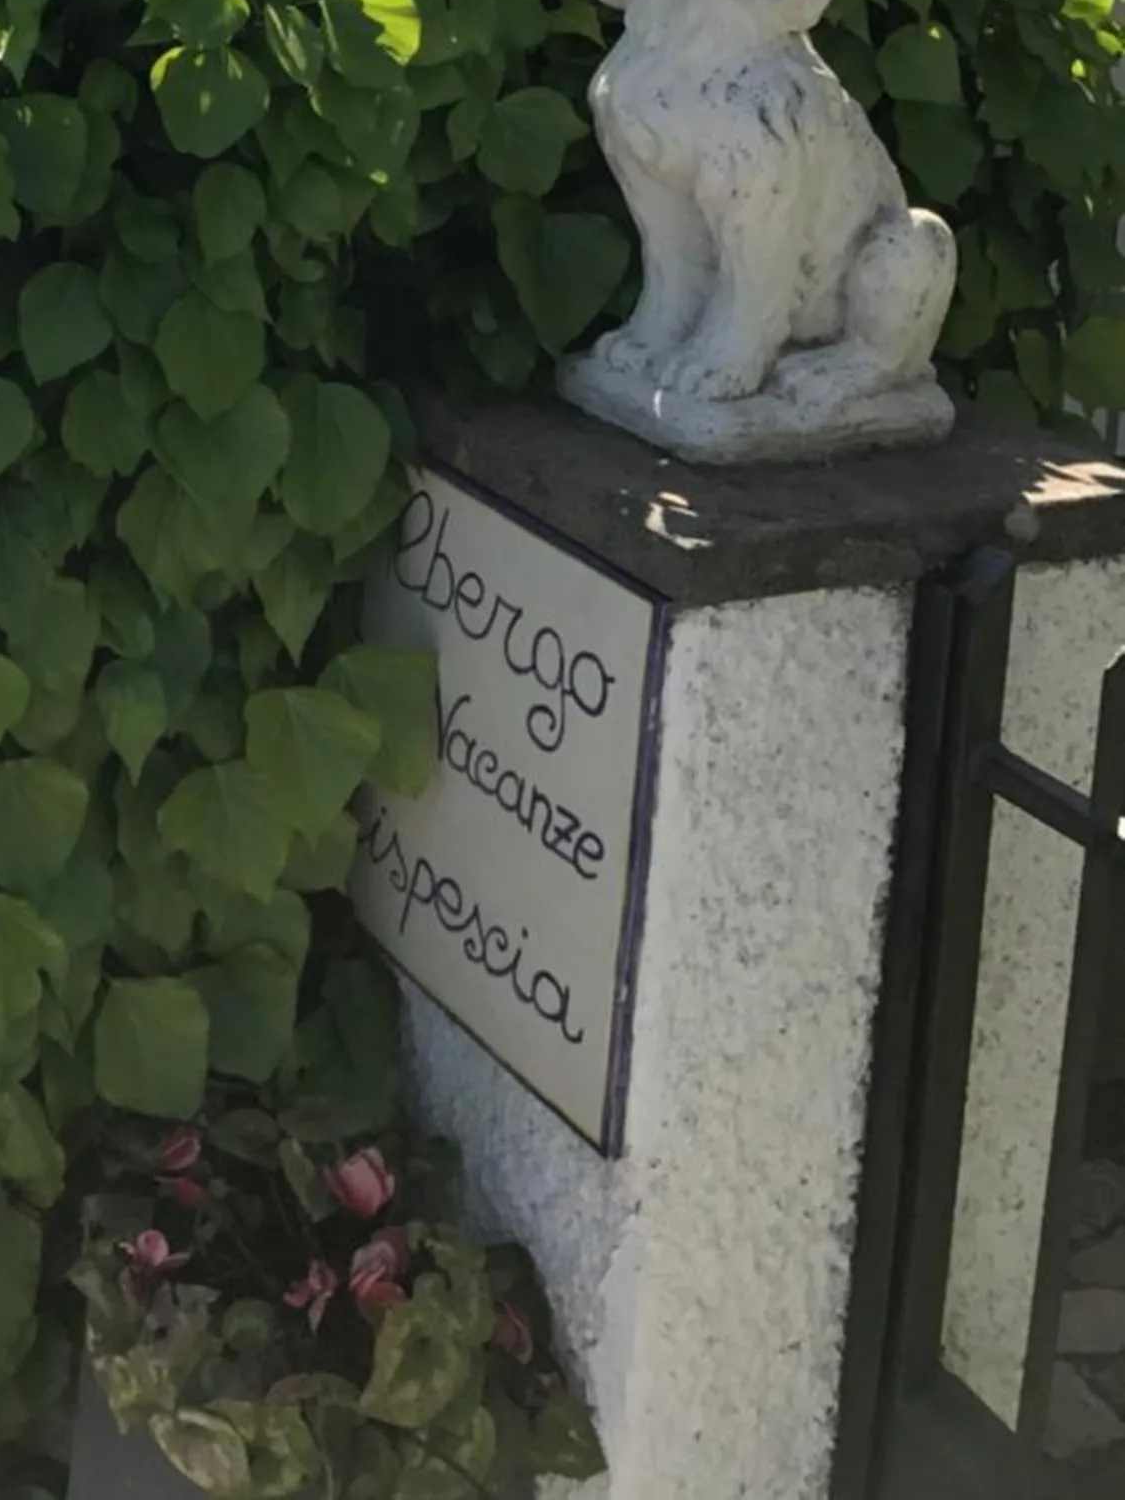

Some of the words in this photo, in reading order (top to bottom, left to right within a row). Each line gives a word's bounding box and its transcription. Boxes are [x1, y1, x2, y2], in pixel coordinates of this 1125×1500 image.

[387, 489, 615, 752] lbergo
[435, 678, 605, 880] Vacanze
[357, 805, 584, 1044] ispescia
